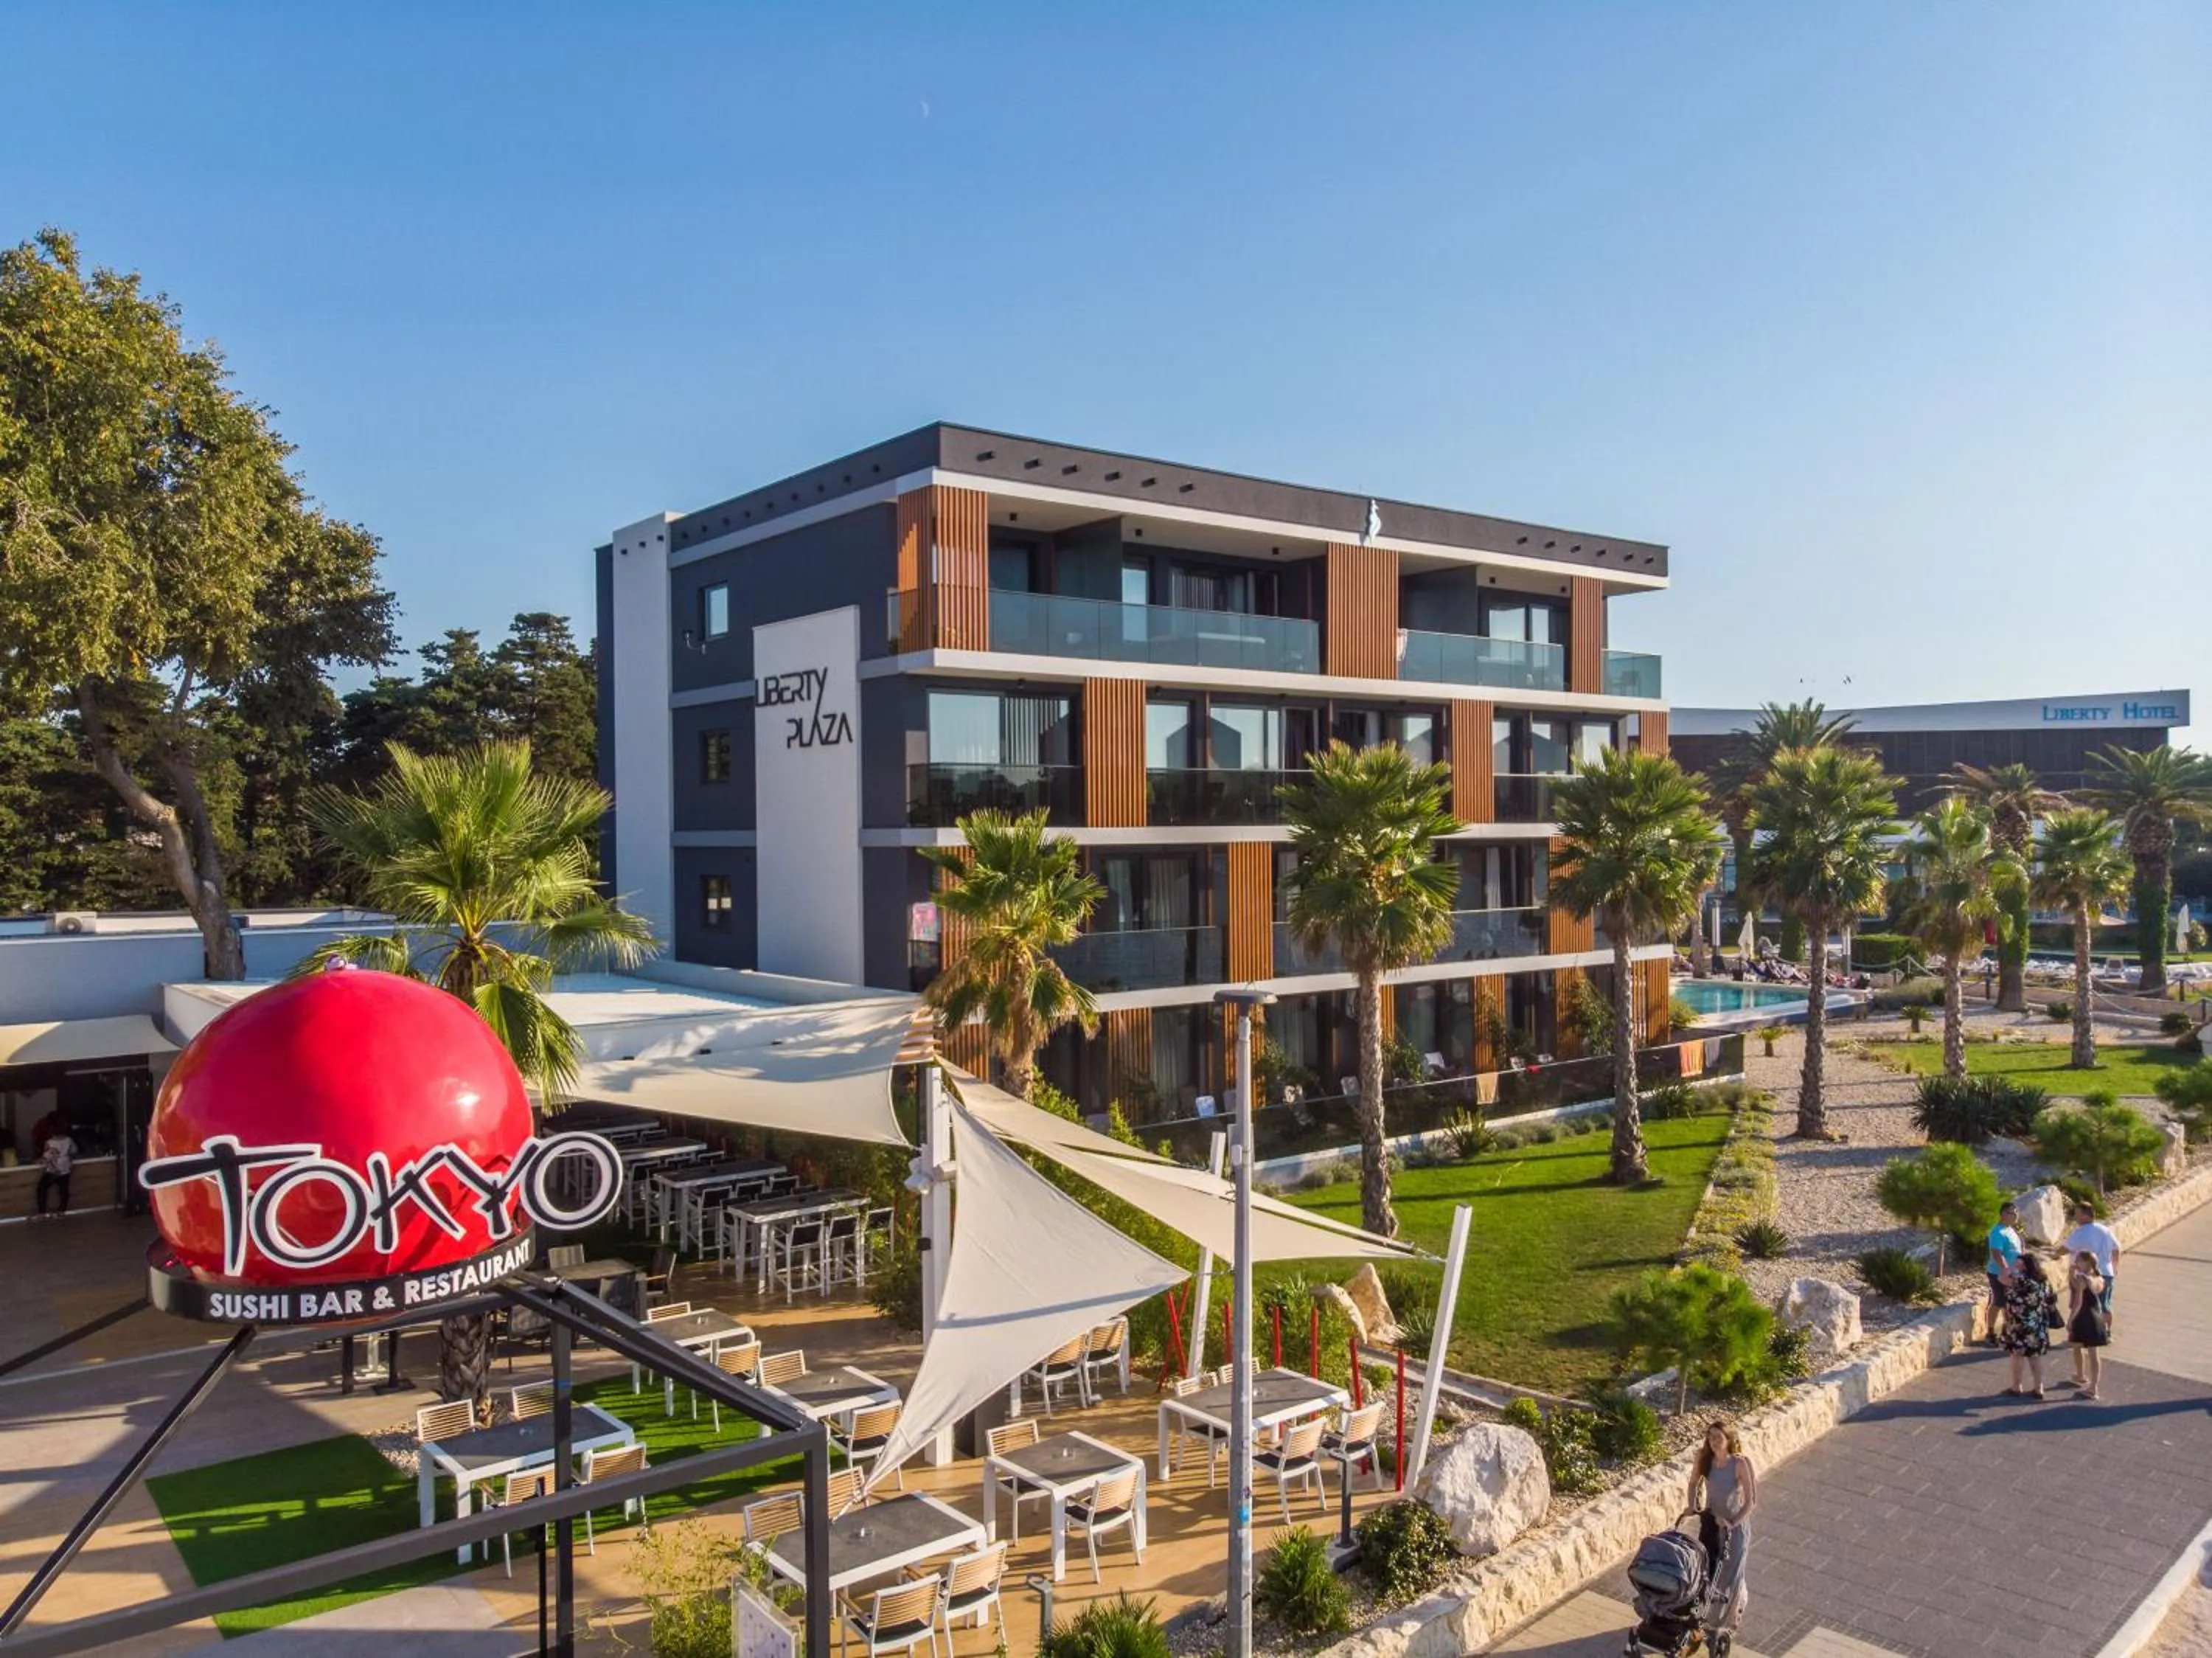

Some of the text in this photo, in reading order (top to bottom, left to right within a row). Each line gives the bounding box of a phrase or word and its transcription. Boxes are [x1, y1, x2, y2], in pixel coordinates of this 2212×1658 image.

[755, 667, 827, 715] LIBERTY
[2043, 702, 2179, 721] LIBERTY HOTEL
[786, 712, 852, 749] PLAZA
[139, 1131, 624, 1276] TOKYO
[209, 1238, 531, 1319] SUSHI BAR & RESTAURANT
